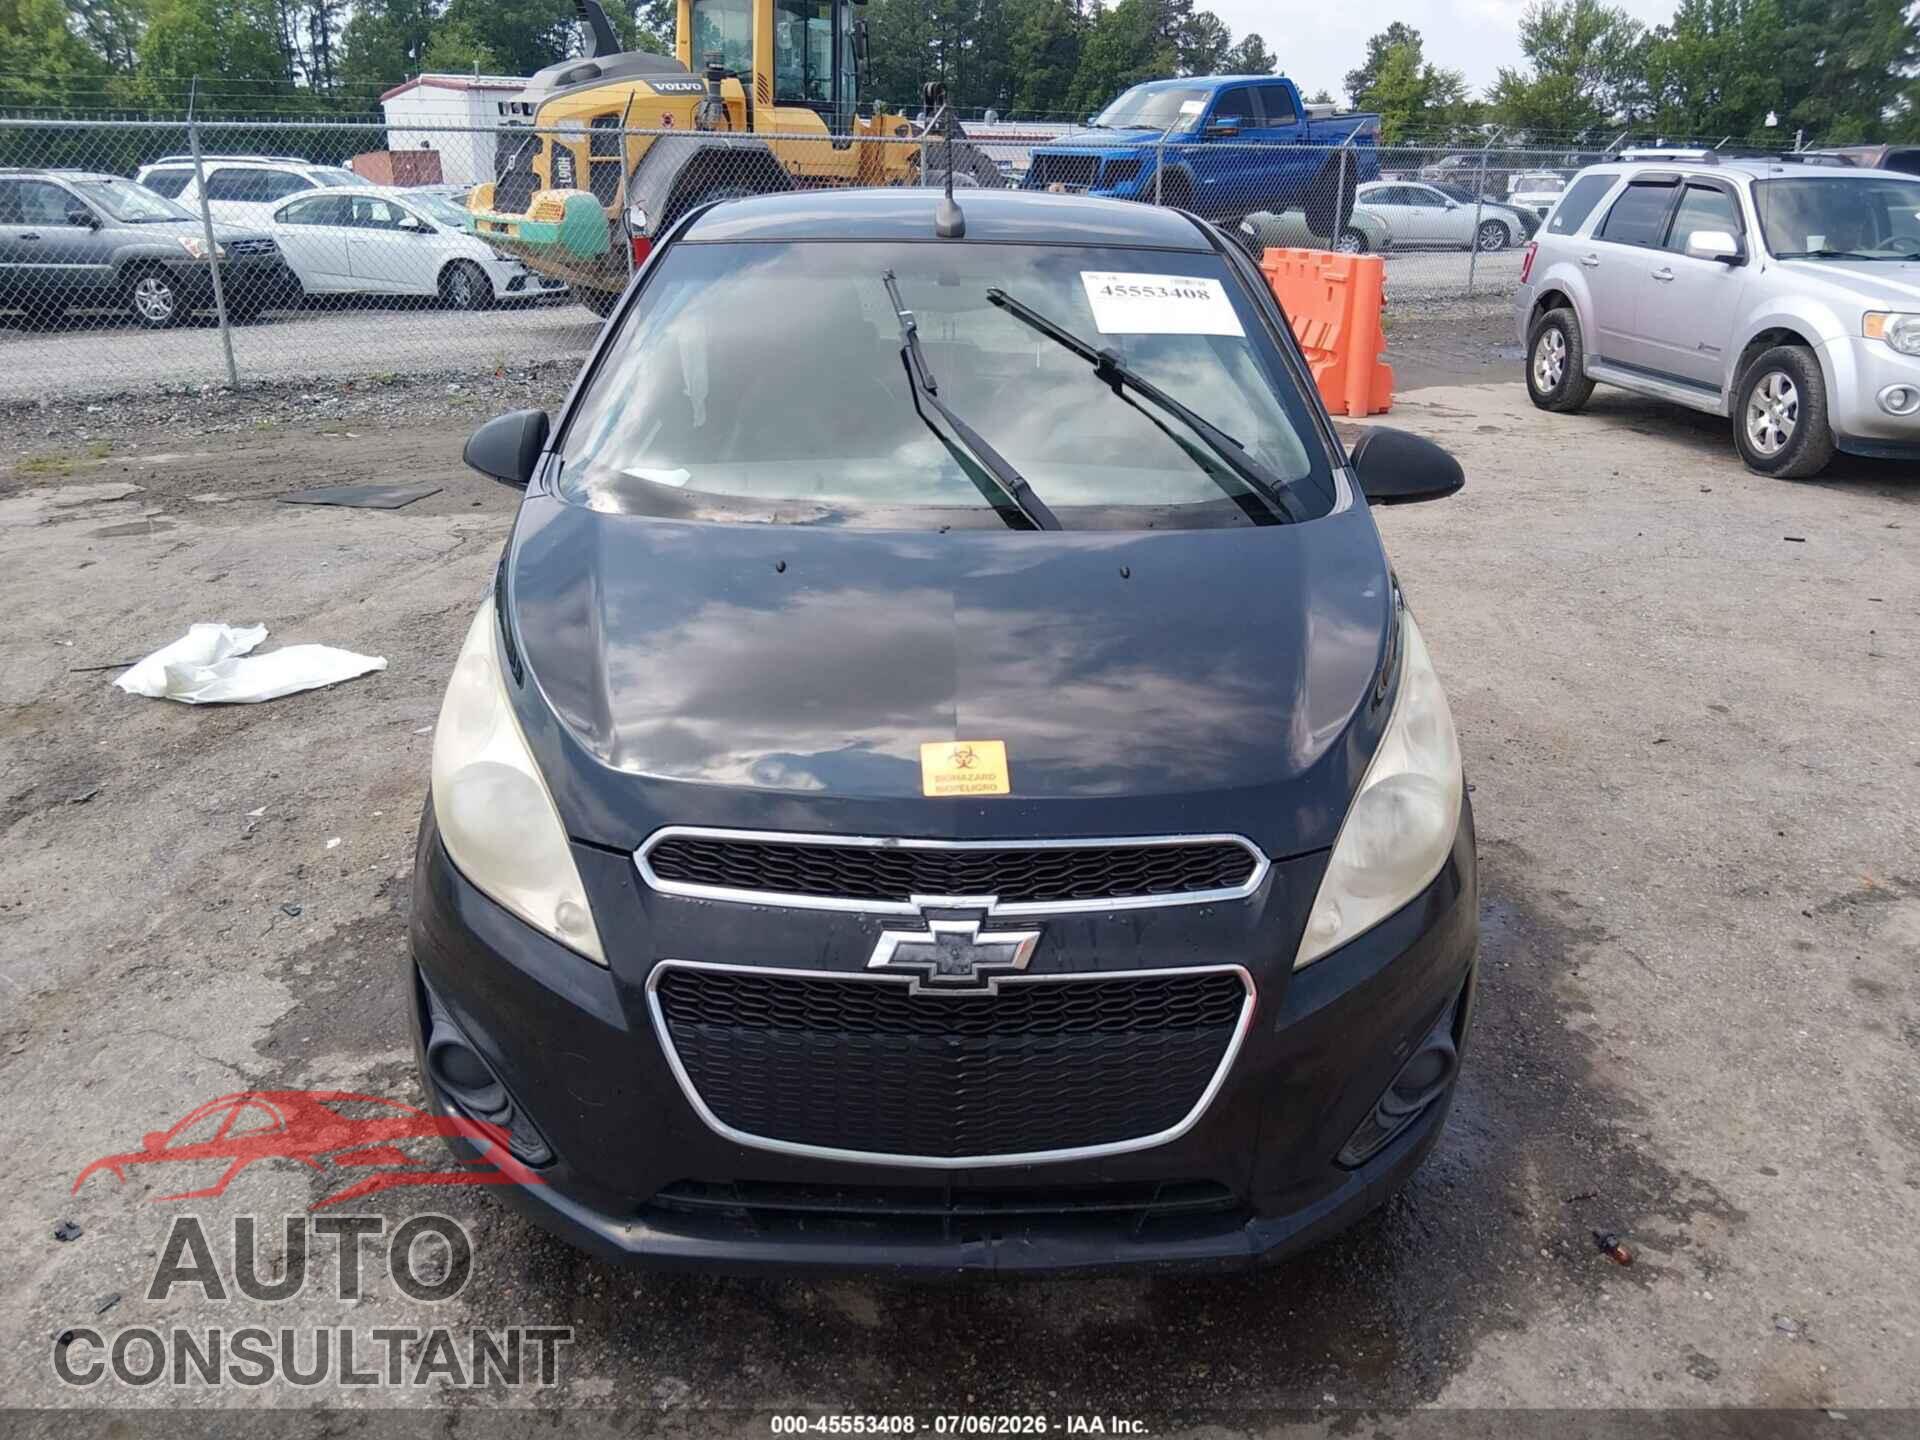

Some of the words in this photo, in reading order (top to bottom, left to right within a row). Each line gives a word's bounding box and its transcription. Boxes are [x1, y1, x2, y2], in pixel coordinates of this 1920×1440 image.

[653, 82, 702, 91] VOLVO
[558, 157, 572, 183] L90H
[1100, 284, 1211, 301] 45553408
[935, 773, 997, 783] BIOHAZARD
[935, 783, 998, 793] BIOPELIGRO
